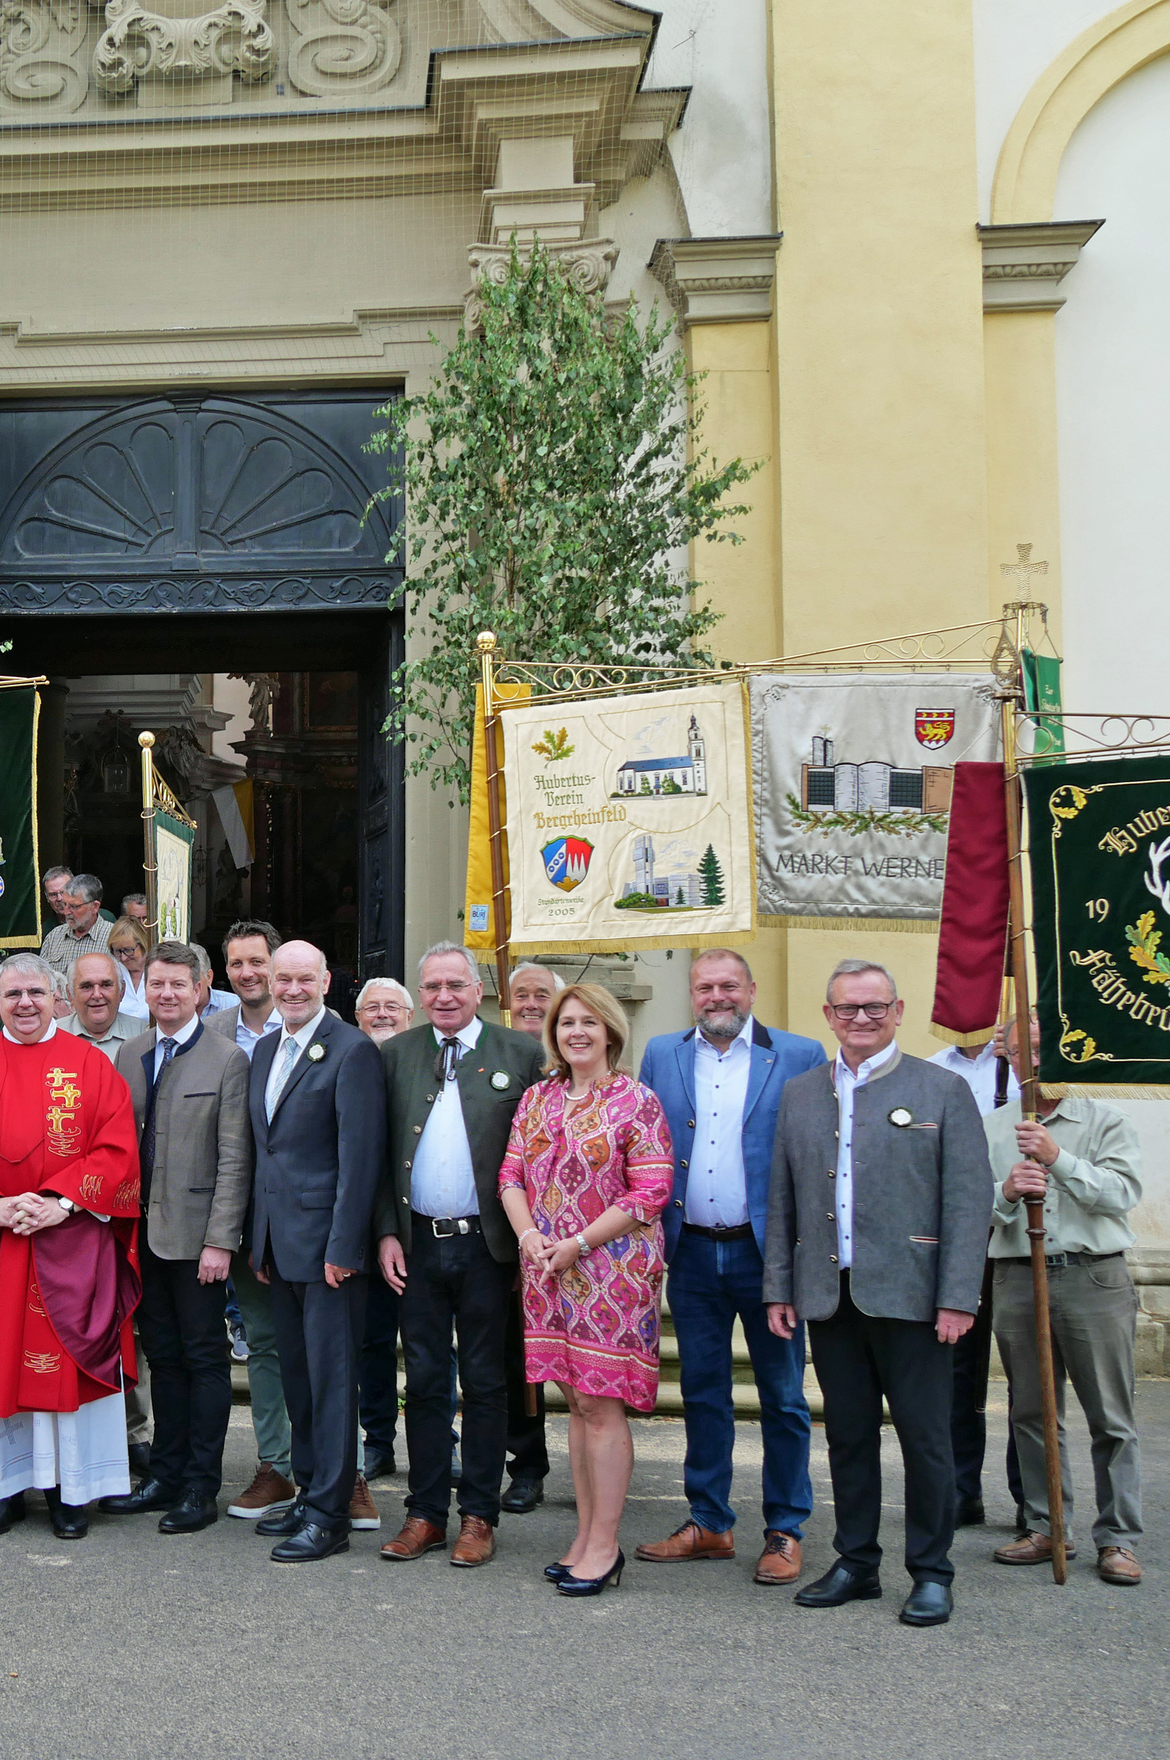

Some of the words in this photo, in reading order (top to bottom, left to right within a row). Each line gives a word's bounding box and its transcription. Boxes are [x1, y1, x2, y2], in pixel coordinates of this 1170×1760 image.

[533, 773, 596, 790] Hubertus-
[544, 790, 584, 807] Verein
[533, 804, 627, 830] Bergrheinfeld
[1097, 805, 1170, 857] Hube
[775, 853, 853, 876] MARKT
[548, 907, 576, 917] 2005
[1084, 898, 1110, 923] 19
